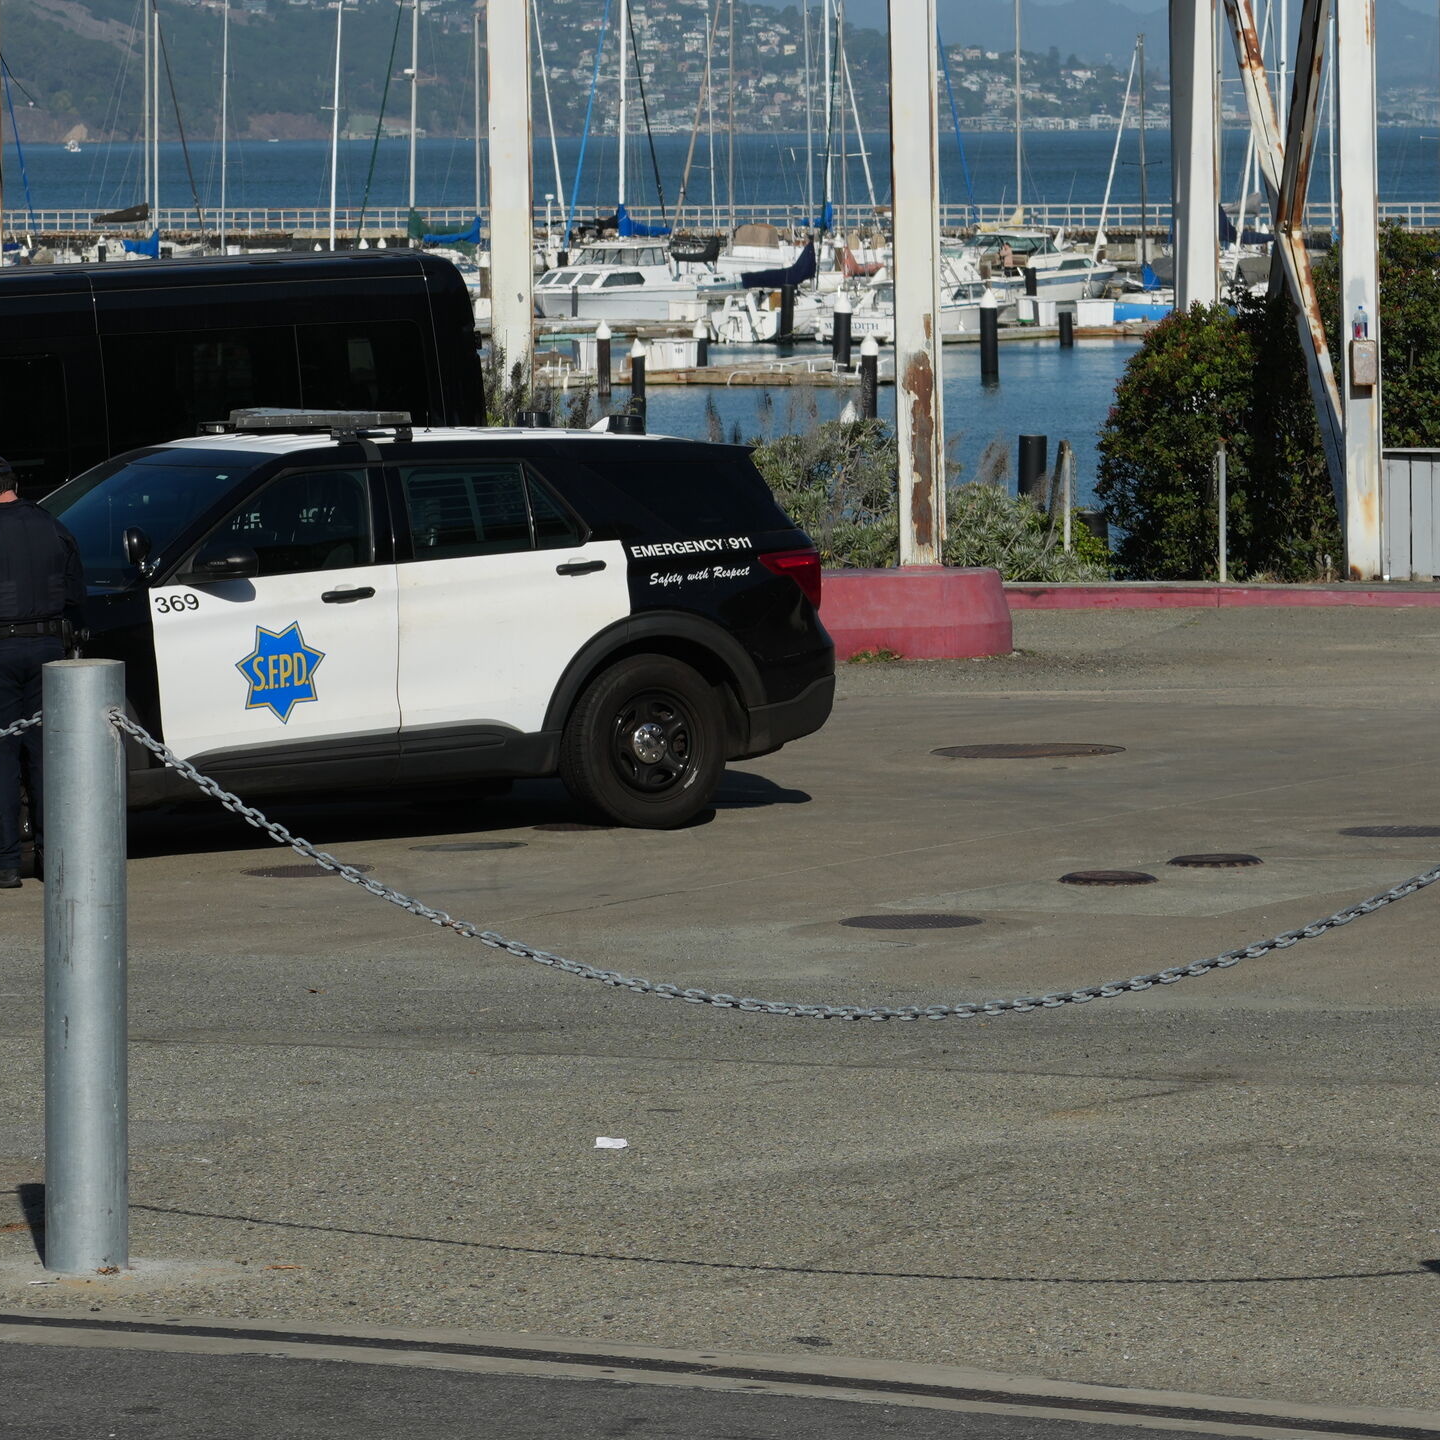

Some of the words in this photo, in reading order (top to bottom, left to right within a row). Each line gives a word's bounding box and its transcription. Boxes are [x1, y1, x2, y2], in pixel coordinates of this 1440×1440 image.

[825, 322, 879, 330] MDITH
[630, 538, 723, 558] EMERGENCY
[728, 536, 753, 549] 911
[649, 572, 684, 587] Safety
[686, 567, 709, 581] with
[712, 565, 751, 580] Respect
[154, 593, 200, 614] 369
[252, 652, 310, 691] S.F.P.D.
